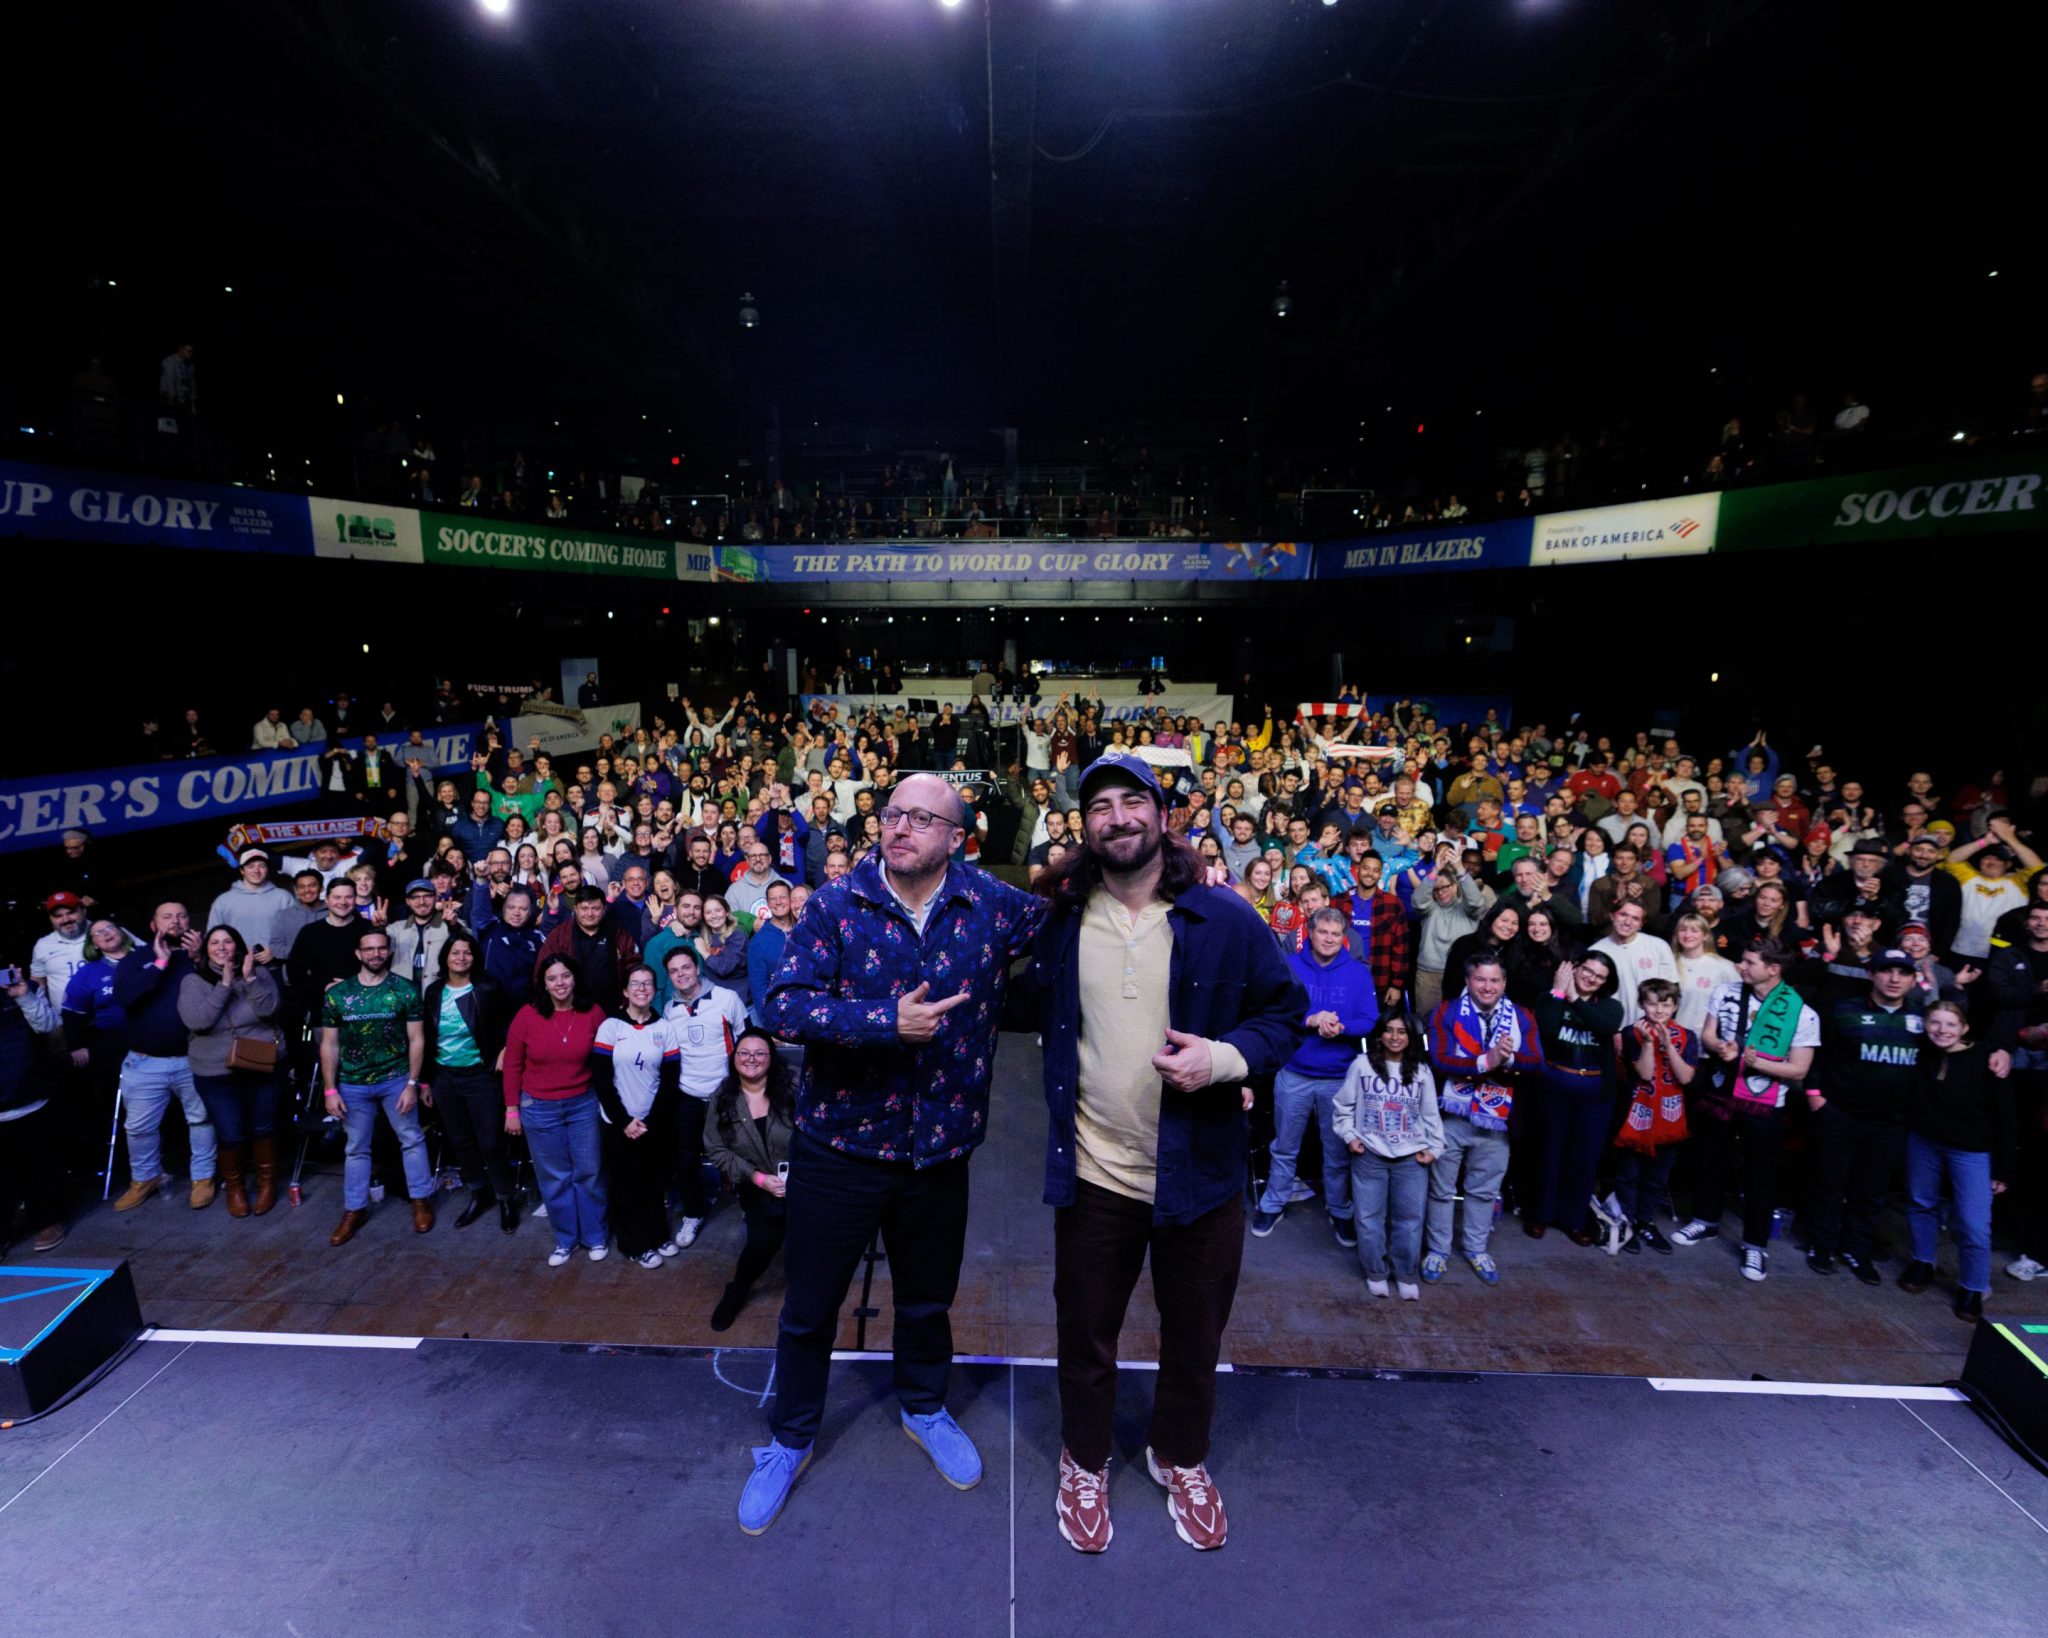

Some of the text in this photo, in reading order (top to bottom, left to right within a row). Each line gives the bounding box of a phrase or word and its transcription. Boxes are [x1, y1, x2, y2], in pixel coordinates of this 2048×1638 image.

[69, 488, 220, 531] GLORY
[1833, 474, 2042, 527] SOCCER
[349, 537, 398, 548] BOSTON
[438, 526, 667, 569] SOCCER'S COMING HOME
[1545, 529, 1666, 551] BANK OF AMERICA
[793, 553, 1176, 573] THE PATH TO WORLD CUP GLORY
[1344, 536, 1486, 569] MEN IN BLAZERS
[467, 683, 535, 694] FUCK TRUMP
[177, 754, 323, 810] COMIN
[266, 820, 358, 838] THE VILLANS
[1760, 1024, 1782, 1049] FC
[634, 1051, 644, 1071] 4
[1860, 1043, 1919, 1066] MAINE
[1360, 1075, 1424, 1099] UCON
